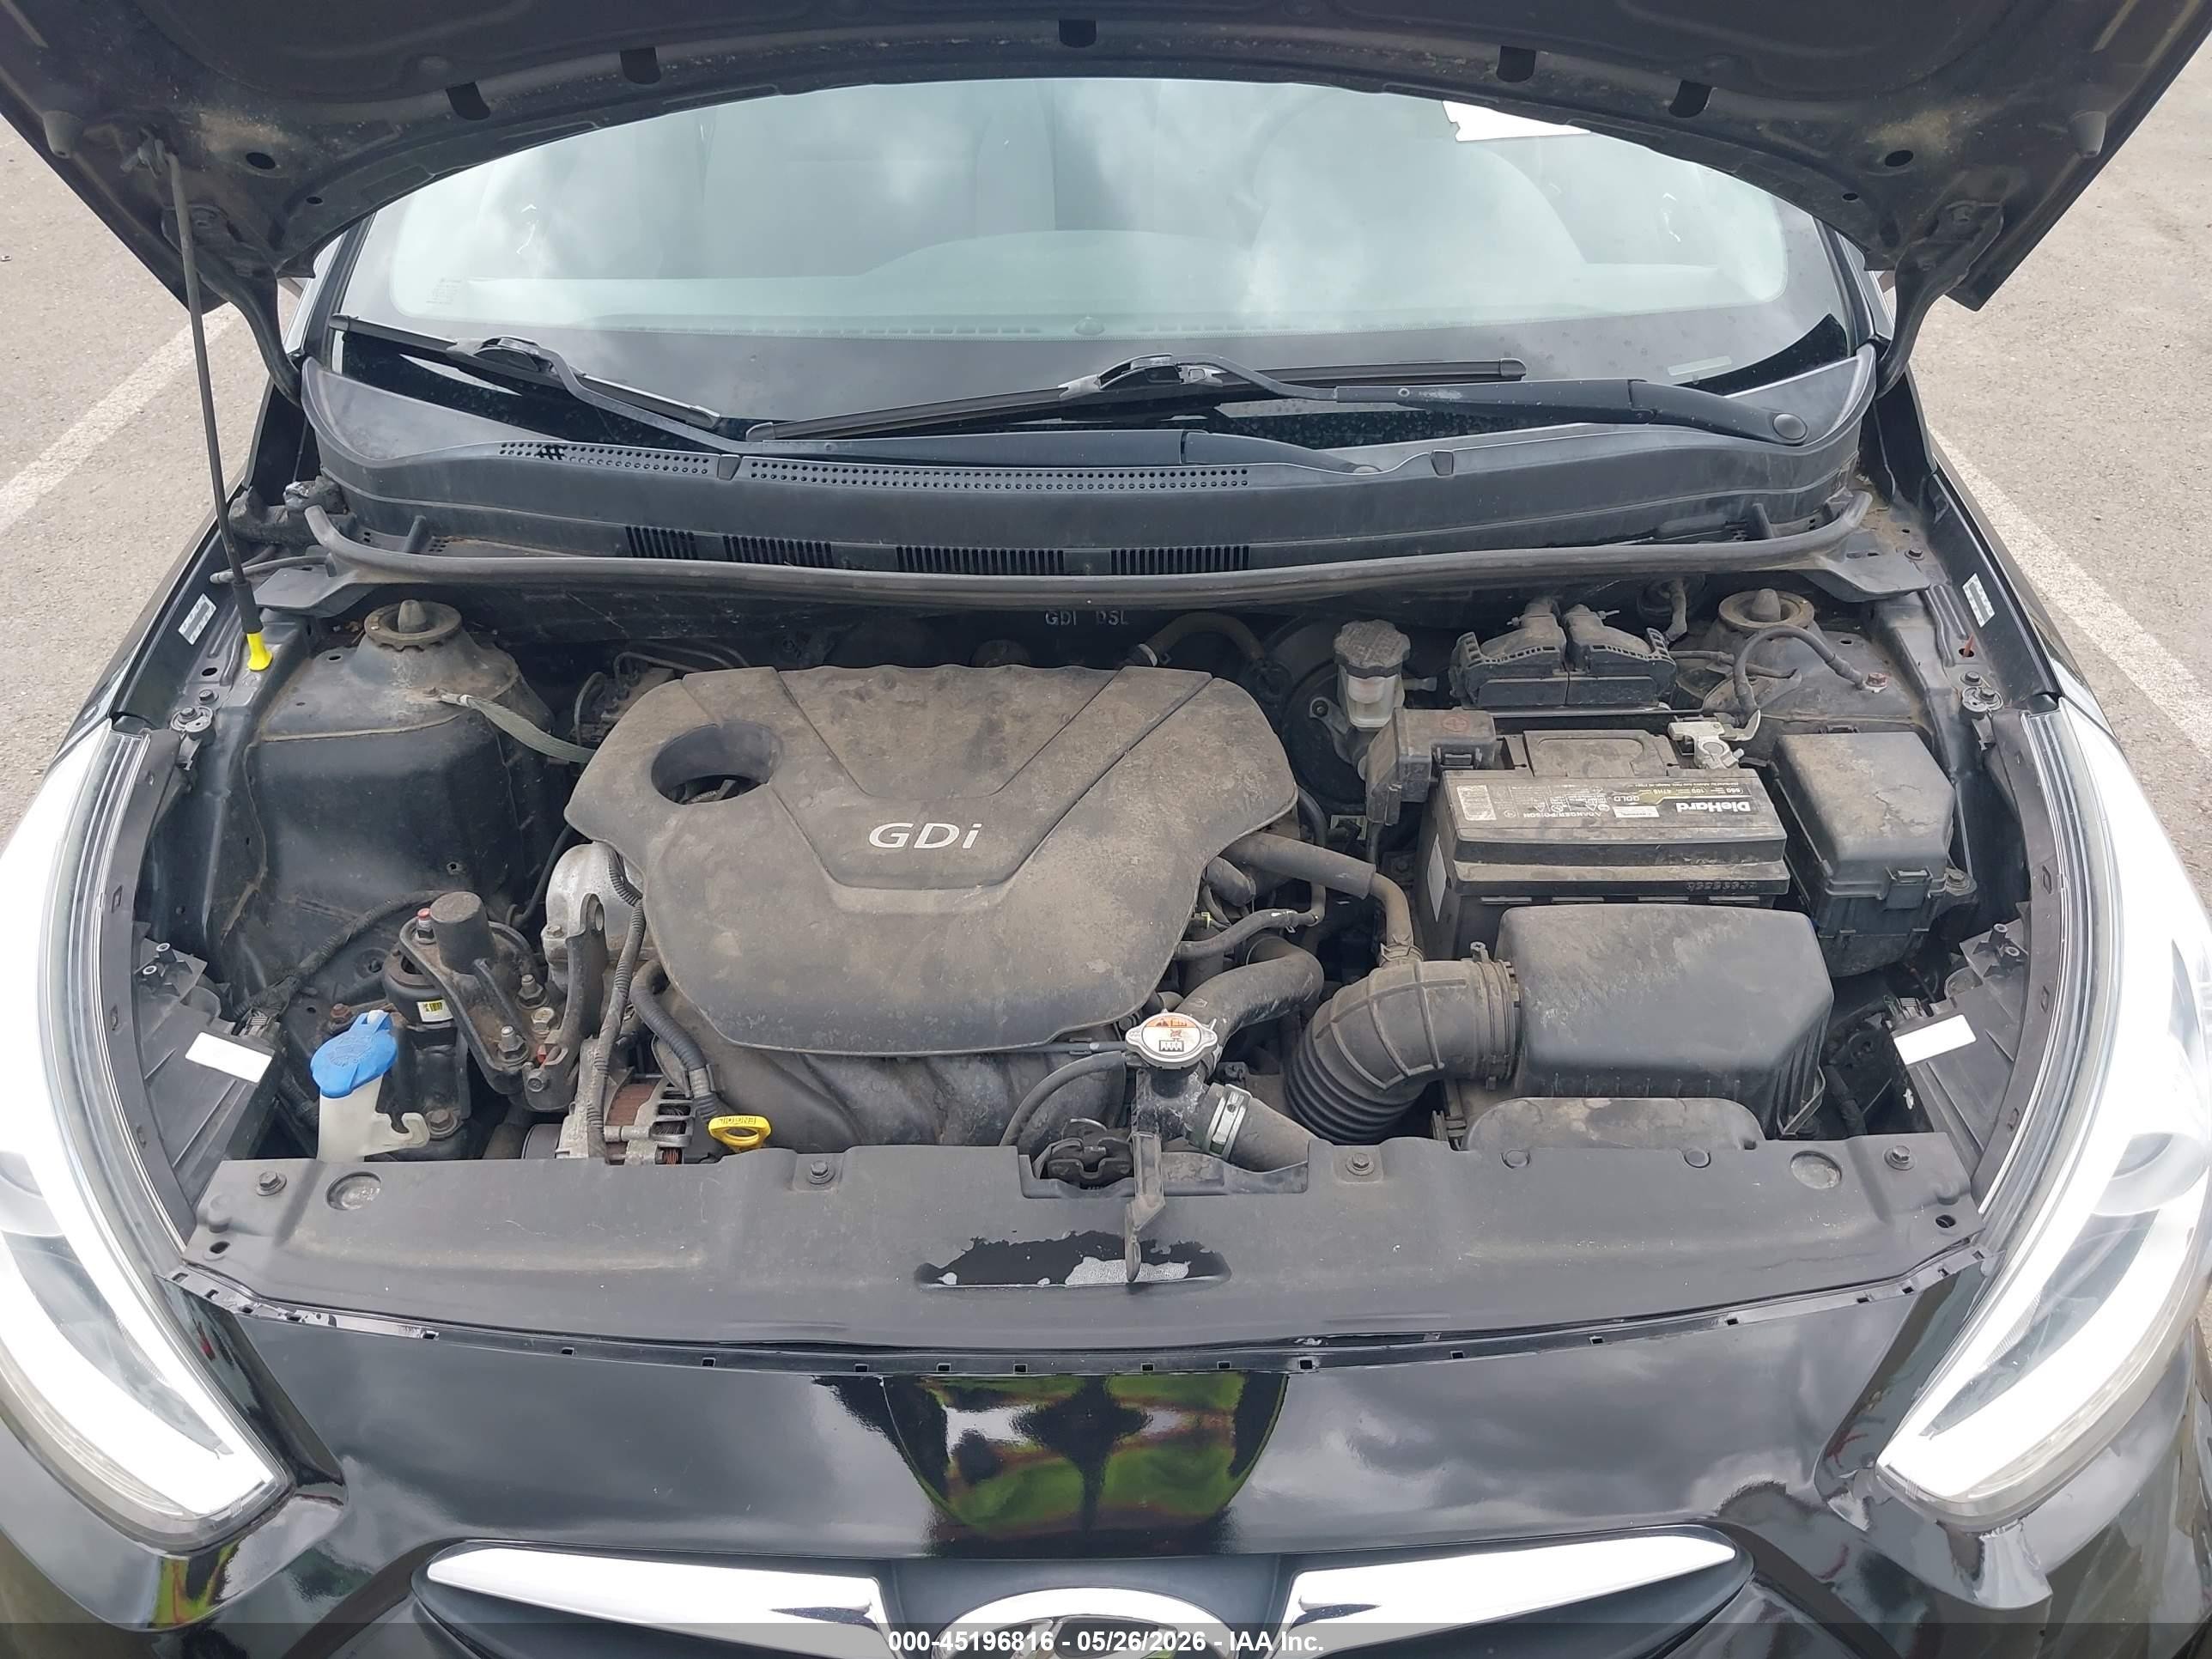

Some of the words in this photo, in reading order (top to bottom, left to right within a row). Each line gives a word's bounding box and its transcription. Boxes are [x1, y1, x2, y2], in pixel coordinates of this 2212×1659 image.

[1045, 610, 1077, 625] GDI
[1613, 794, 1640, 803] GOLD
[1675, 800, 1752, 813] DieHard
[868, 822, 983, 849] GDi
